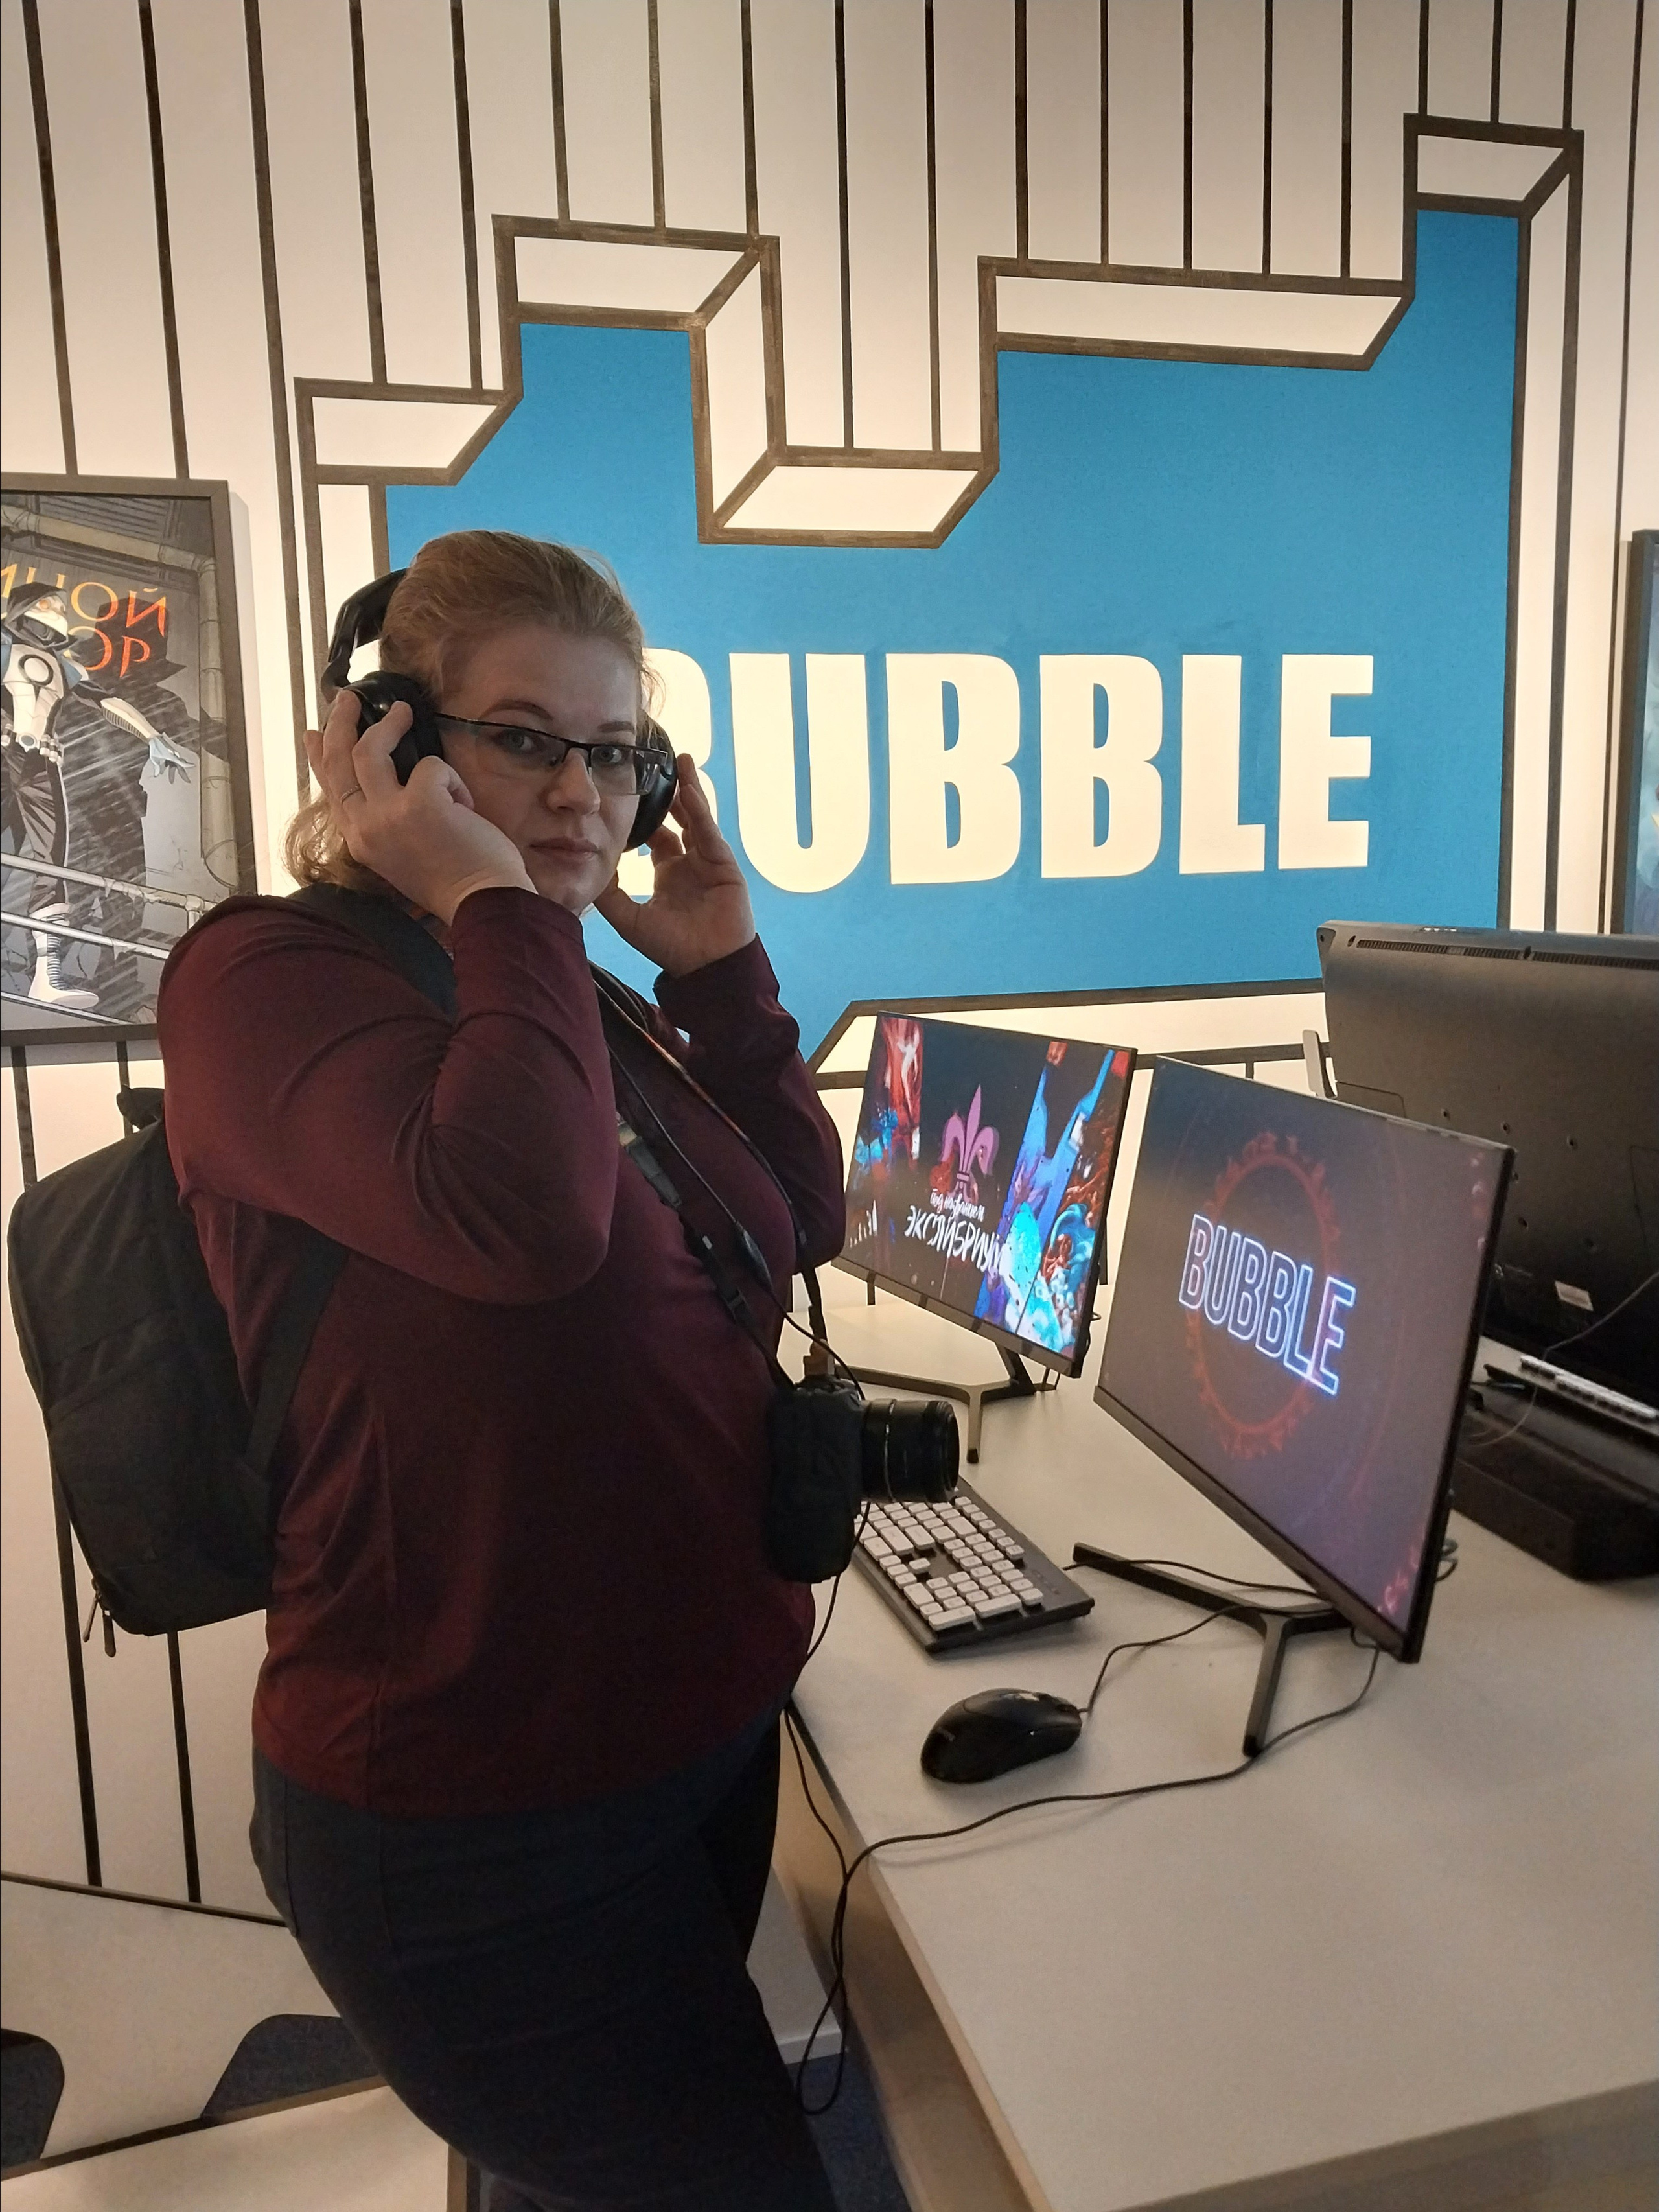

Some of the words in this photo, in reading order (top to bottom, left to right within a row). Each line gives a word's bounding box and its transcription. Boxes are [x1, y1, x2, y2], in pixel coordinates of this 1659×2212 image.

[1, 563, 166, 638] ОЙ
[64, 625, 150, 678] ОР
[1179, 1213, 1356, 1395] BUBBLE
